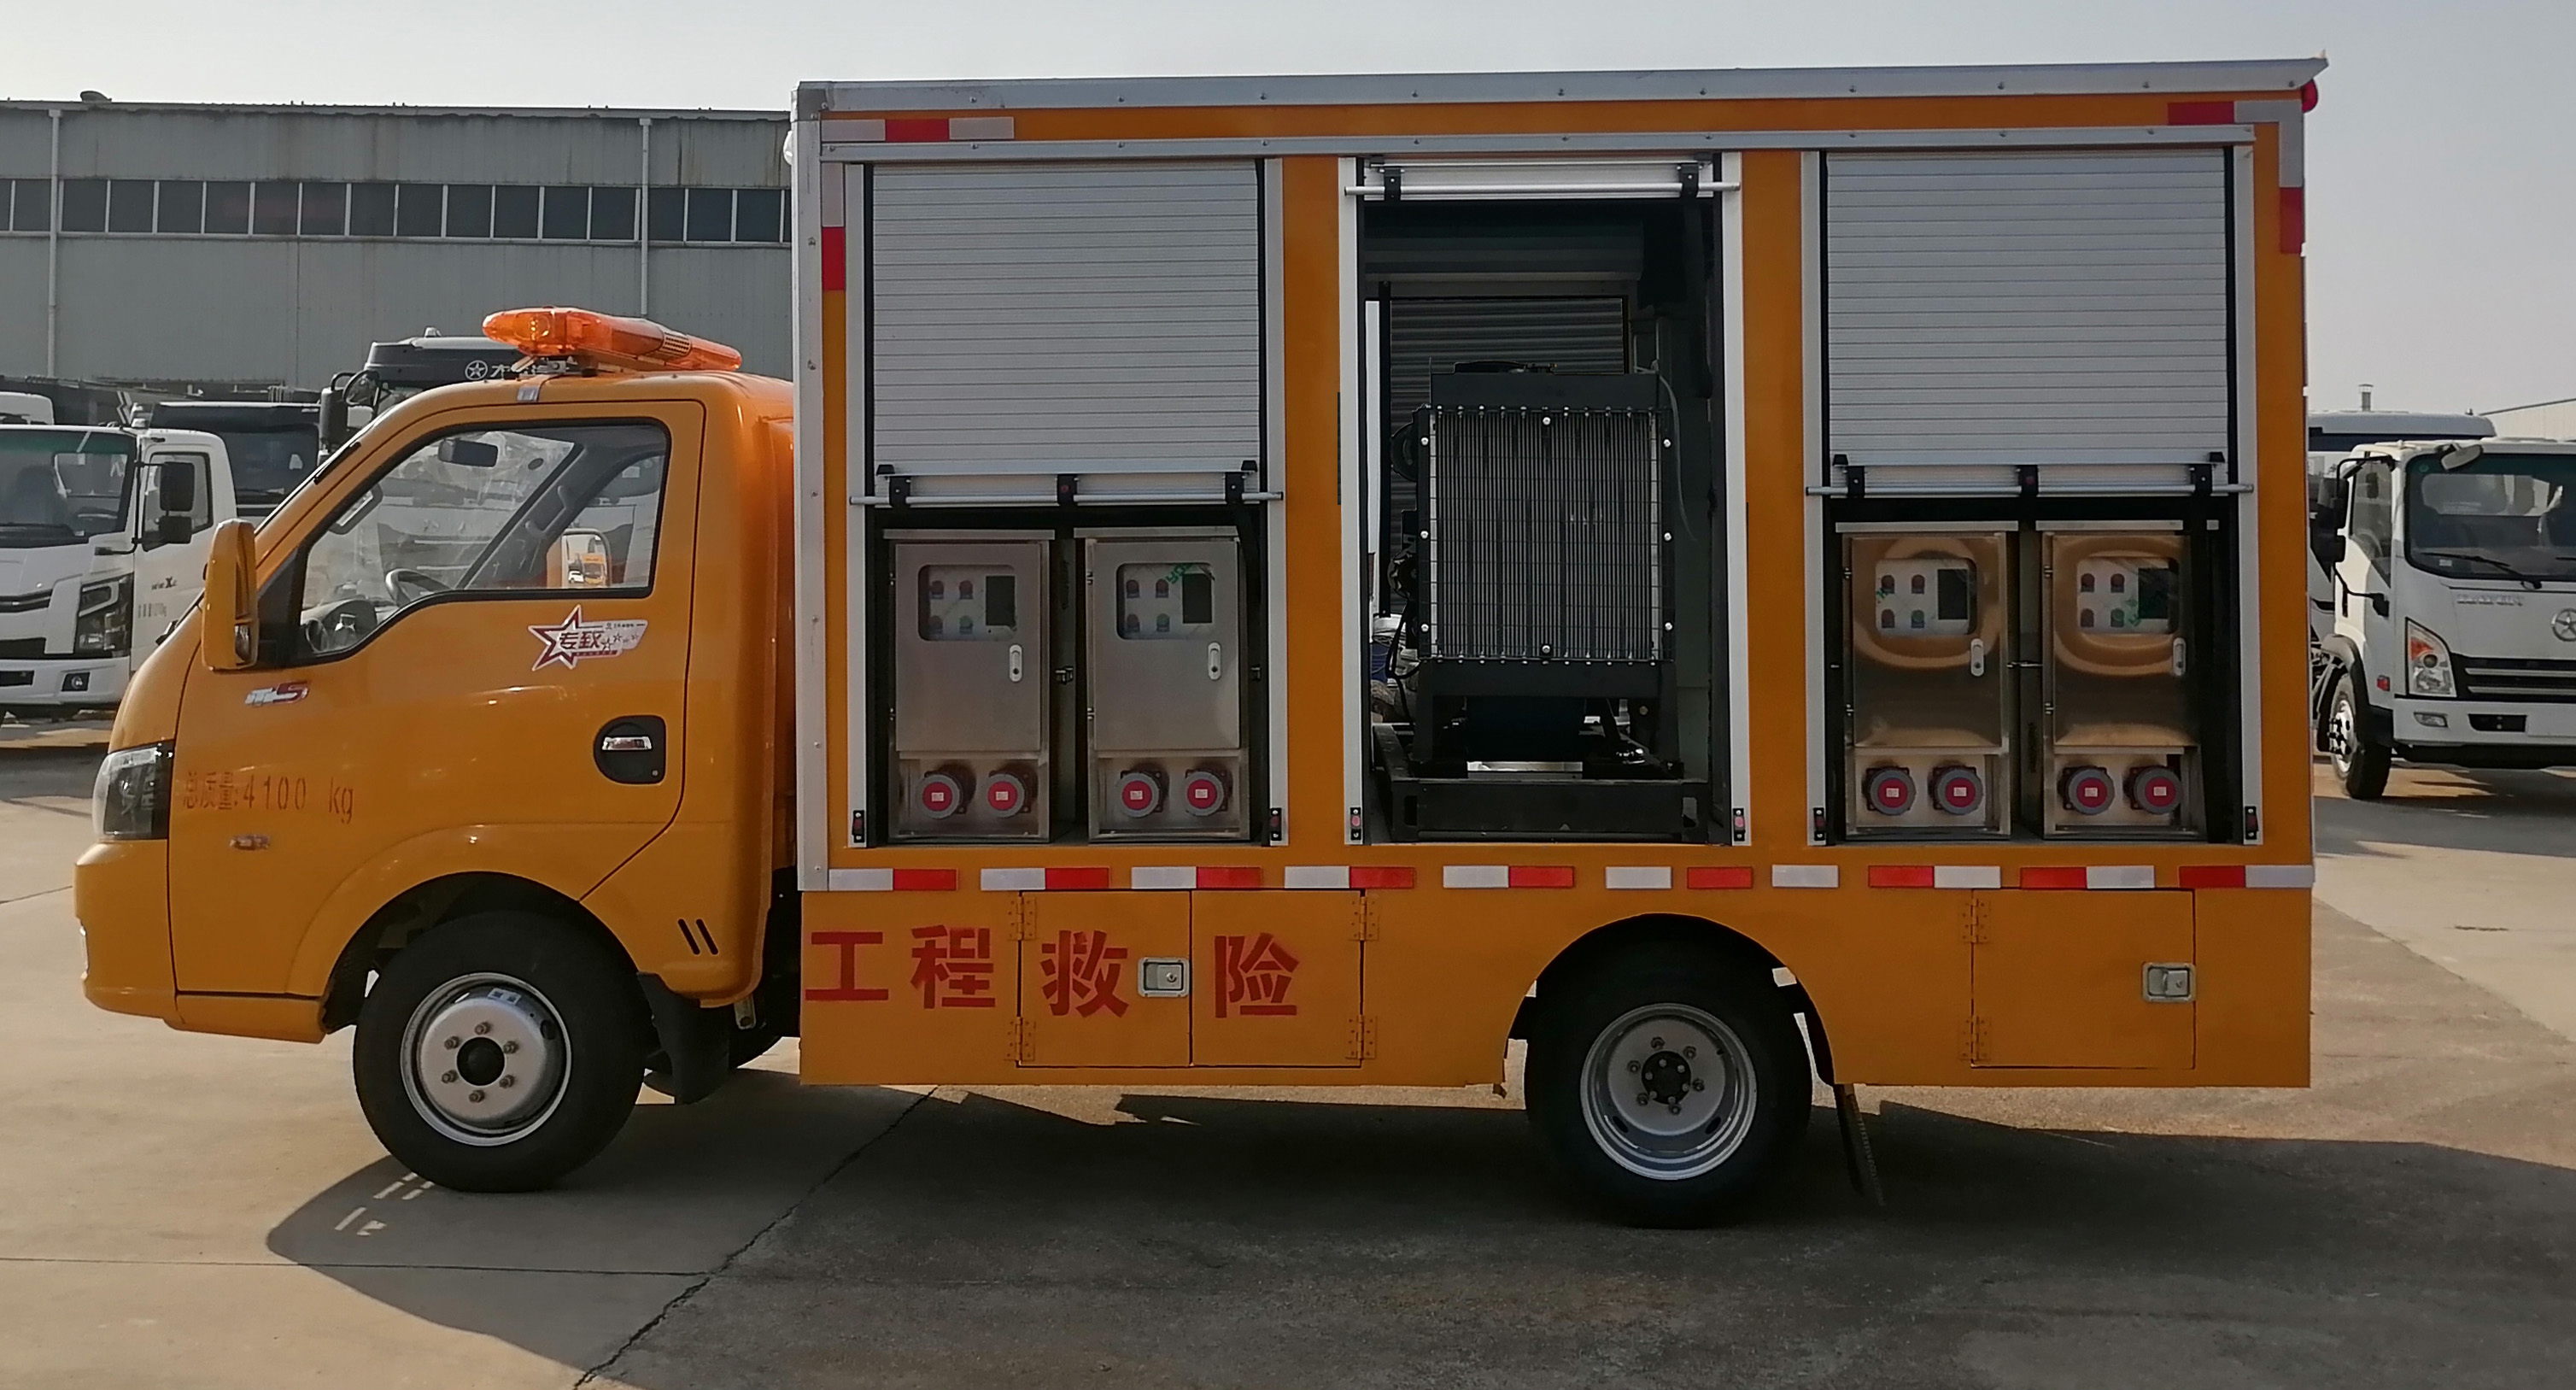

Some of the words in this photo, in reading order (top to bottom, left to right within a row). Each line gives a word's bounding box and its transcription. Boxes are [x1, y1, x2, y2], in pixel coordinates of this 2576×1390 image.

[559, 630, 604, 649] 专致
[183, 771, 307, 811] 总质量:4100
[329, 777, 354, 824] kg
[805, 924, 1302, 1019] 工程救险
